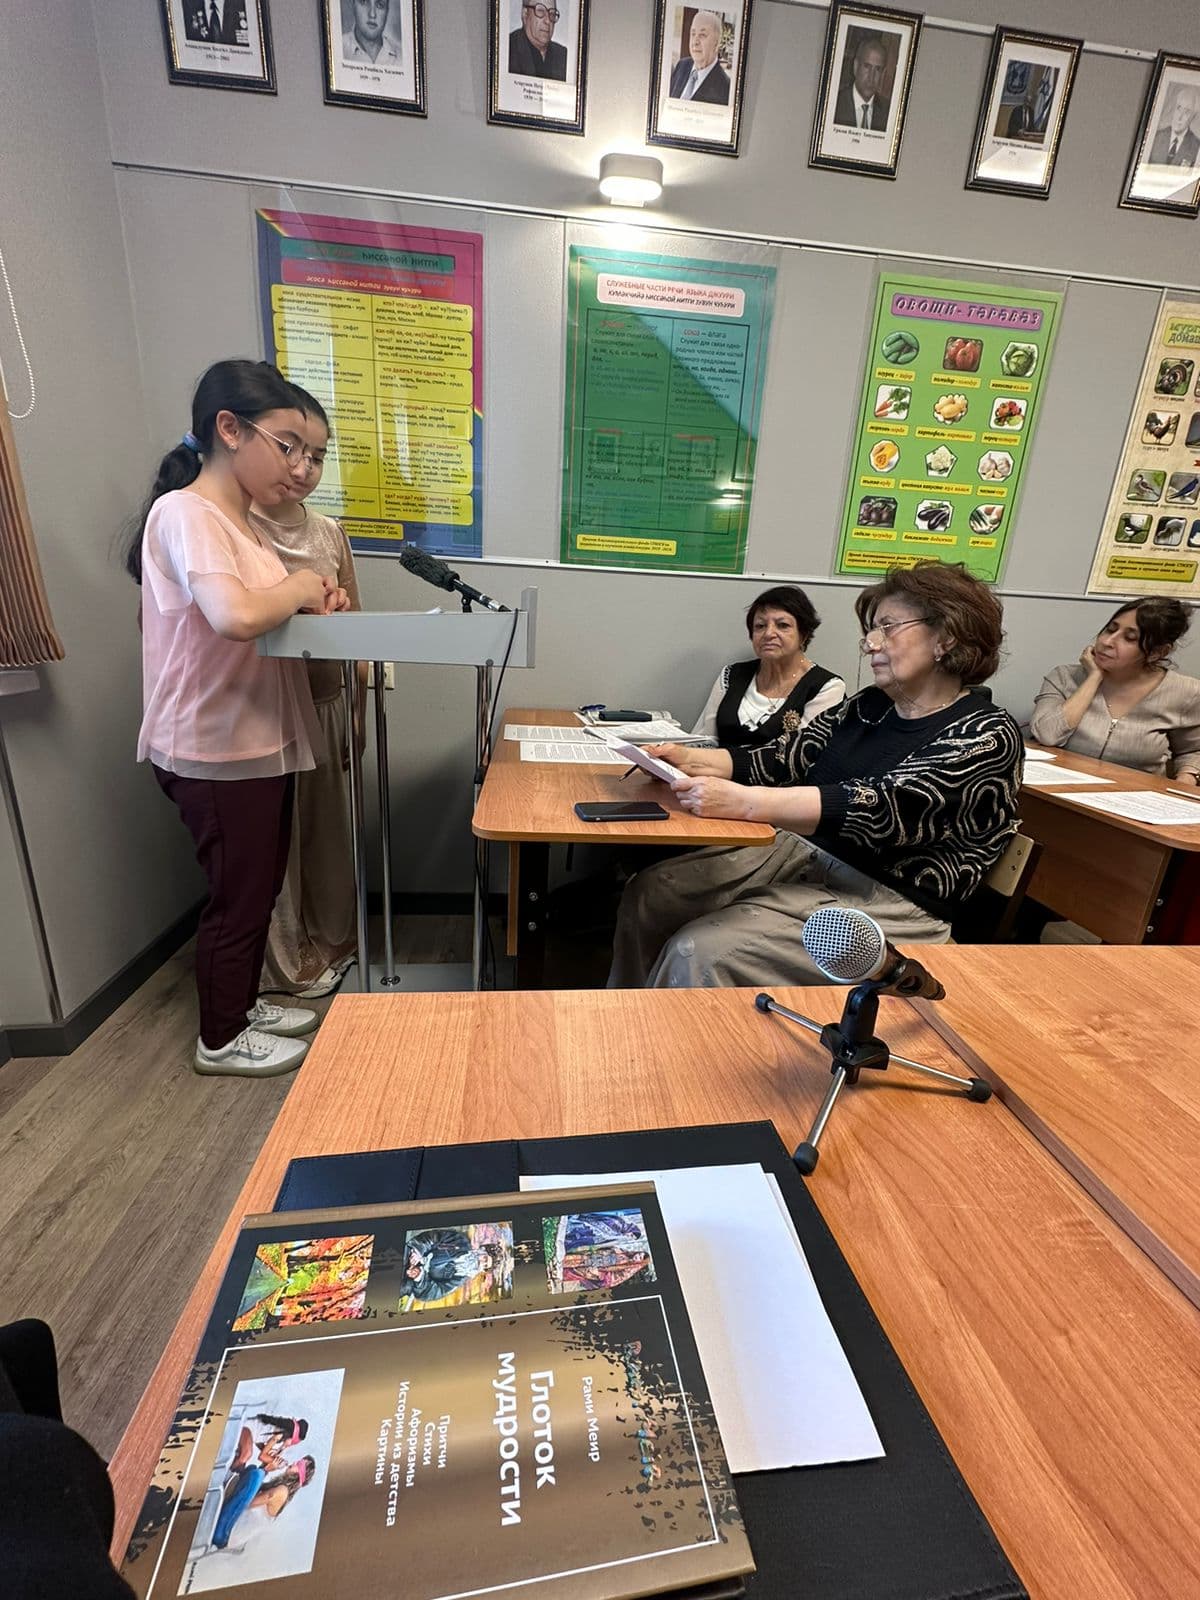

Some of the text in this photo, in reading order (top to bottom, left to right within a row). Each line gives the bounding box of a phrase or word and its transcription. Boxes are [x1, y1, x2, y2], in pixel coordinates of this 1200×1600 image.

[374, 1418, 392, 1485] Картины
[386, 1380, 410, 1527] Истории из детства
[406, 1407, 422, 1487] Афоризмы
[422, 1422, 436, 1466] Стихи
[437, 1415, 450, 1469] Притчи
[492, 1352, 522, 1526] мудрости
[530, 1370, 556, 1490] Глоток
[582, 1376, 601, 1462] Рами Меир
